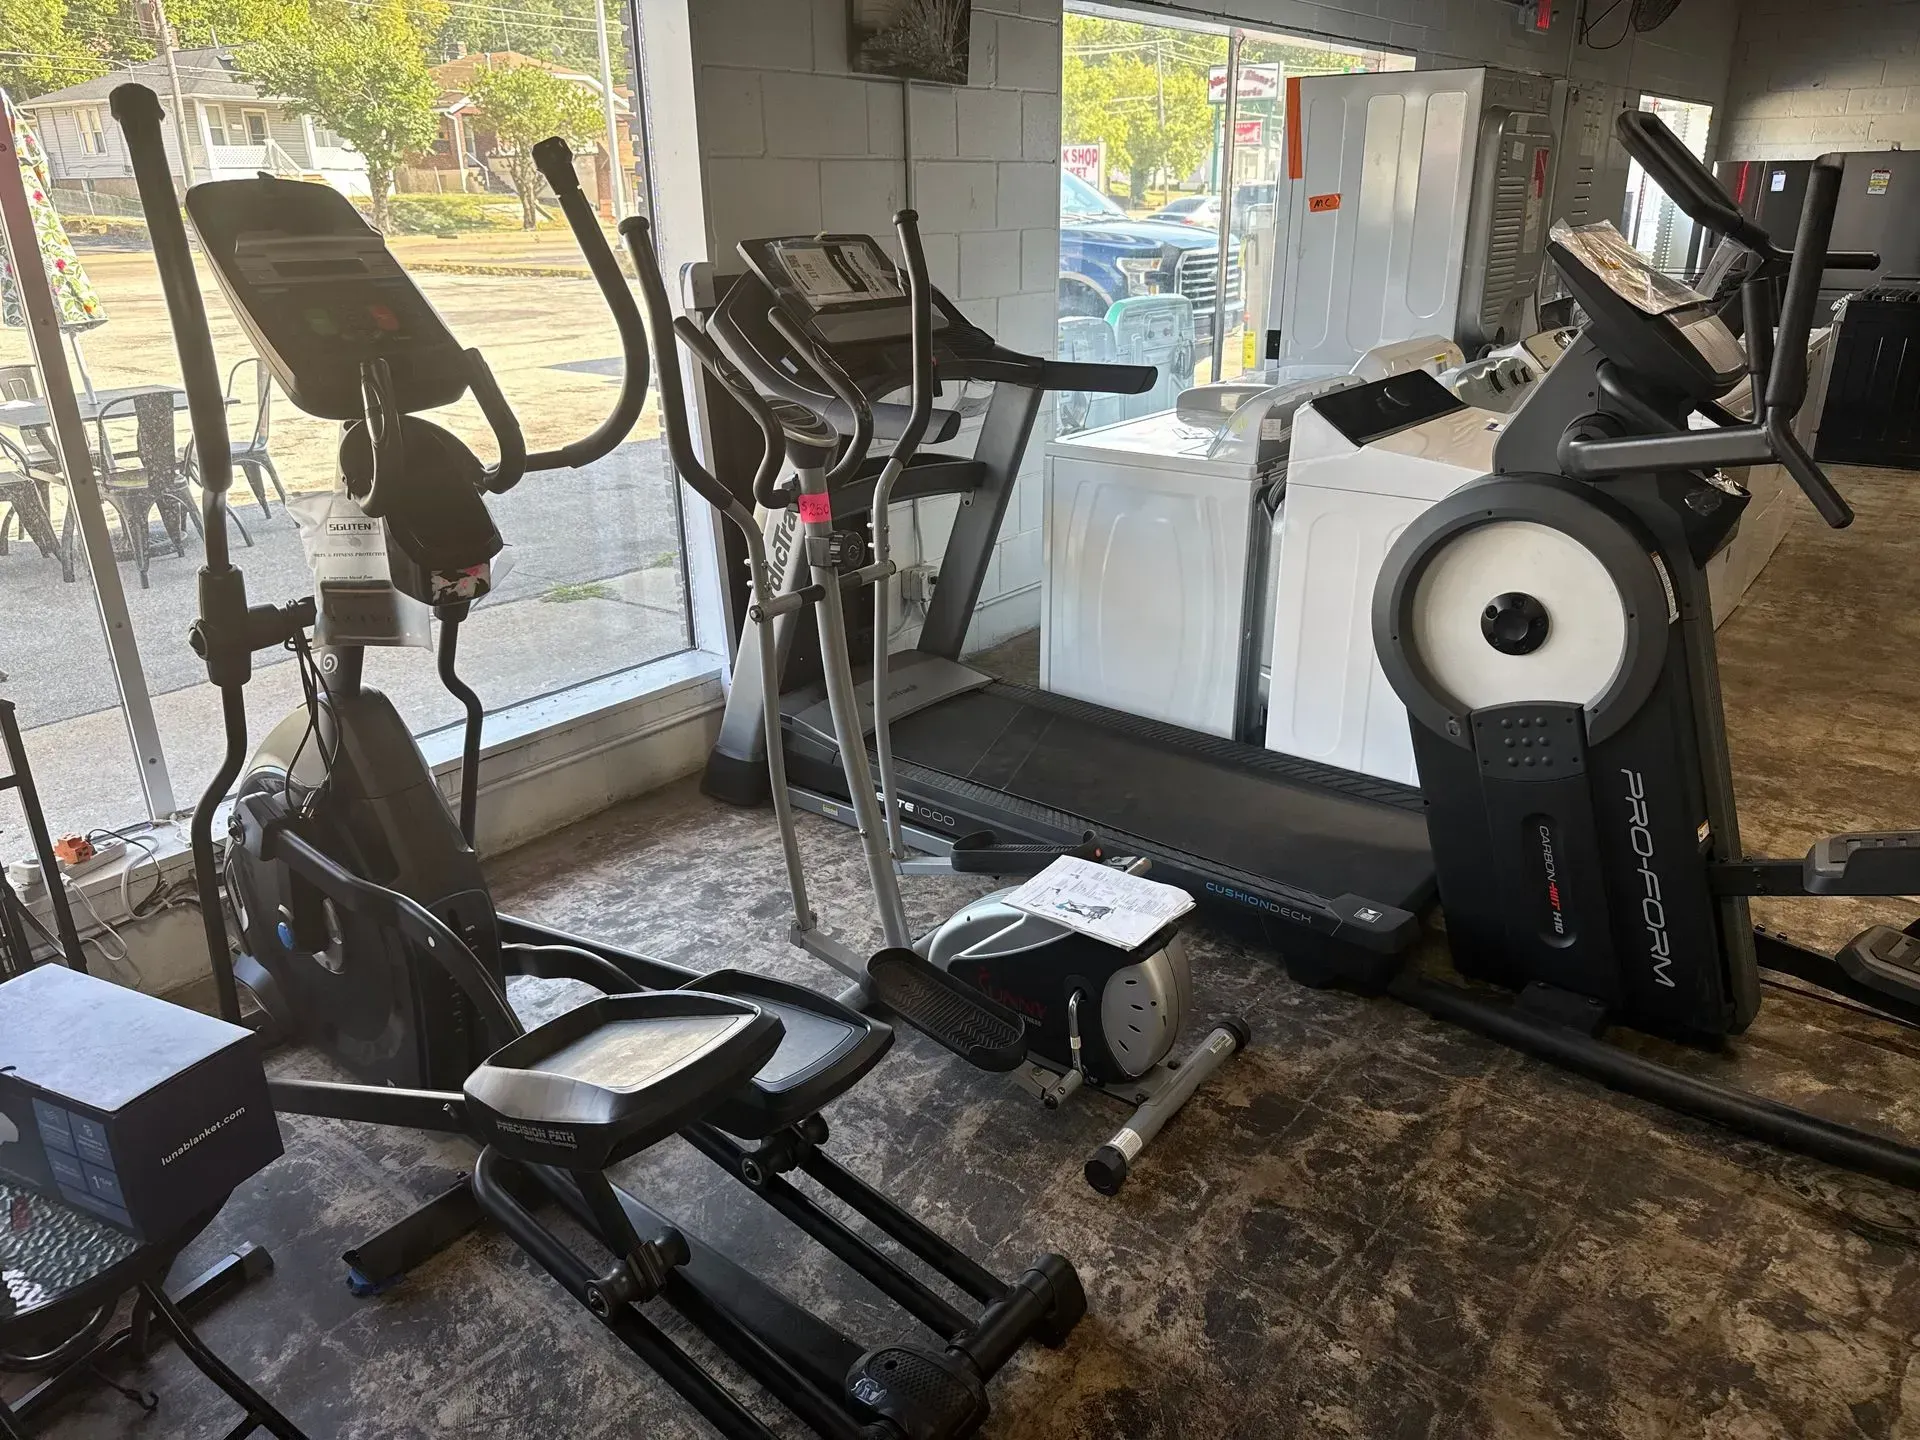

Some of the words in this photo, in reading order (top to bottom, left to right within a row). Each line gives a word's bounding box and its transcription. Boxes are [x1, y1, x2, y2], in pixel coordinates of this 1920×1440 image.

[1072, 148, 1097, 168] SHOP
[329, 523, 372, 532] SGUTEN
[768, 507, 798, 600] dicTra
[876, 791, 915, 813] ETE
[1539, 825, 1557, 882] CARBON
[1553, 911, 1564, 935] H10
[1620, 768, 1676, 988] PRO-FORM
[161, 1106, 246, 1166] lunablanket.com
[496, 1120, 546, 1138] PRECISION
[548, 1130, 576, 1142] PATH
